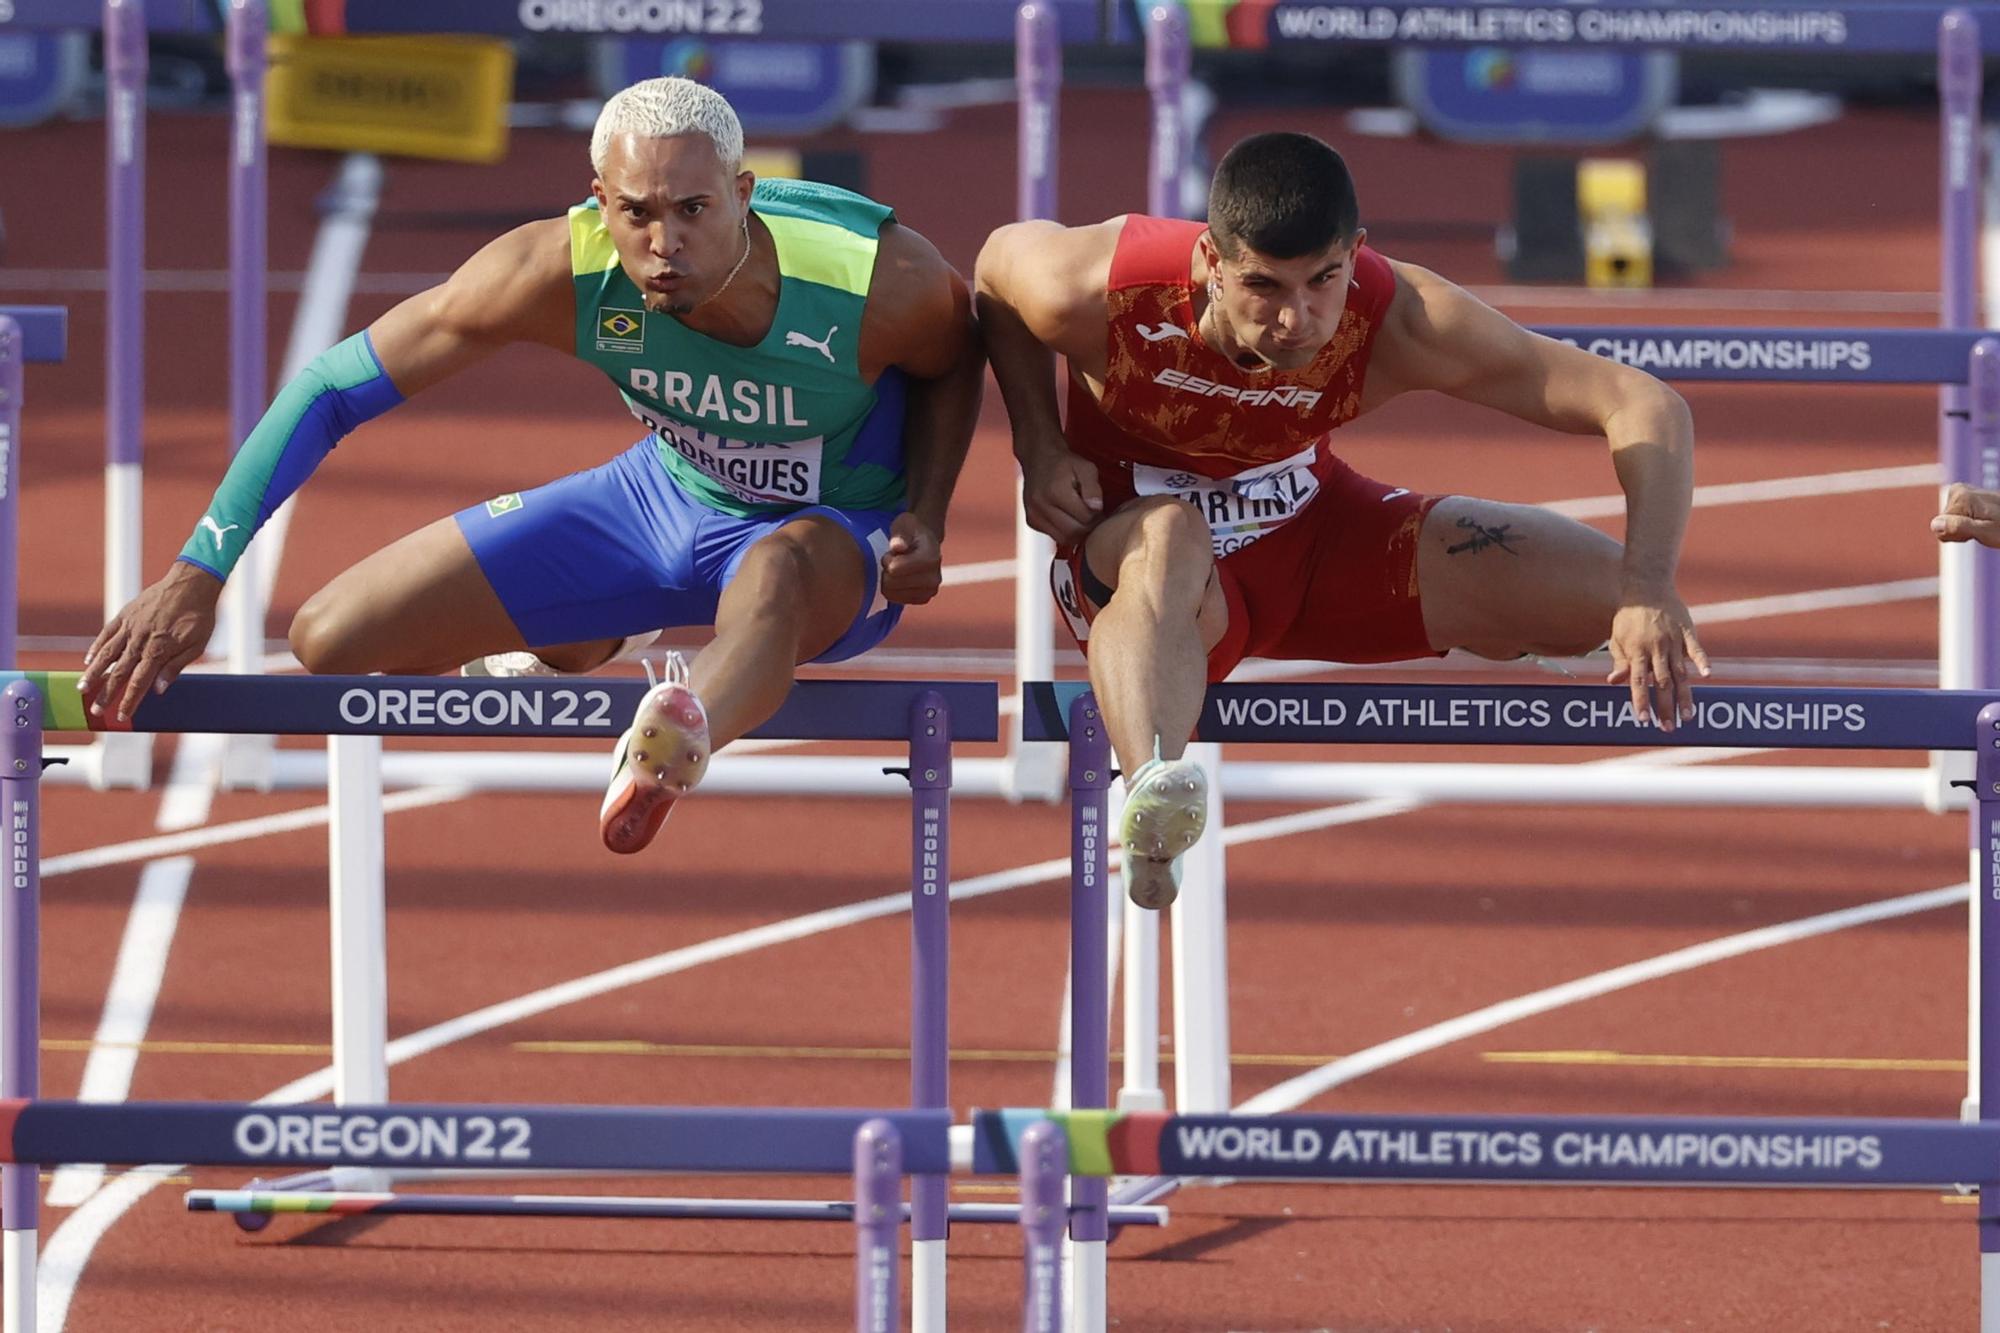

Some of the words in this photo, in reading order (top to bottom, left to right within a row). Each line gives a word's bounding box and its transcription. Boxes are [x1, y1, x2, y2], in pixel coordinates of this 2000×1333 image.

[1276, 6, 1398, 40] WORLD
[1400, 8, 1574, 42] ATHLETICS
[1577, 9, 1847, 44] CHAMPIONSHIPS
[630, 368, 808, 427] BRASIL
[1152, 367, 1323, 410] ESPAÑA
[339, 689, 612, 727] OREGON22
[1216, 699, 1347, 726] WORLD
[1356, 700, 1551, 729] ATHLETICS
[14, 815, 28, 888] MONDO
[923, 823, 938, 896] MONDO
[1082, 823, 1098, 887] MONDO
[236, 1114, 531, 1159] OREGON22
[1178, 1126, 1322, 1161] WORLD
[1329, 1129, 1543, 1166] ATHLETICS
[1553, 1133, 1882, 1169] CHAMPIONSHIPS
